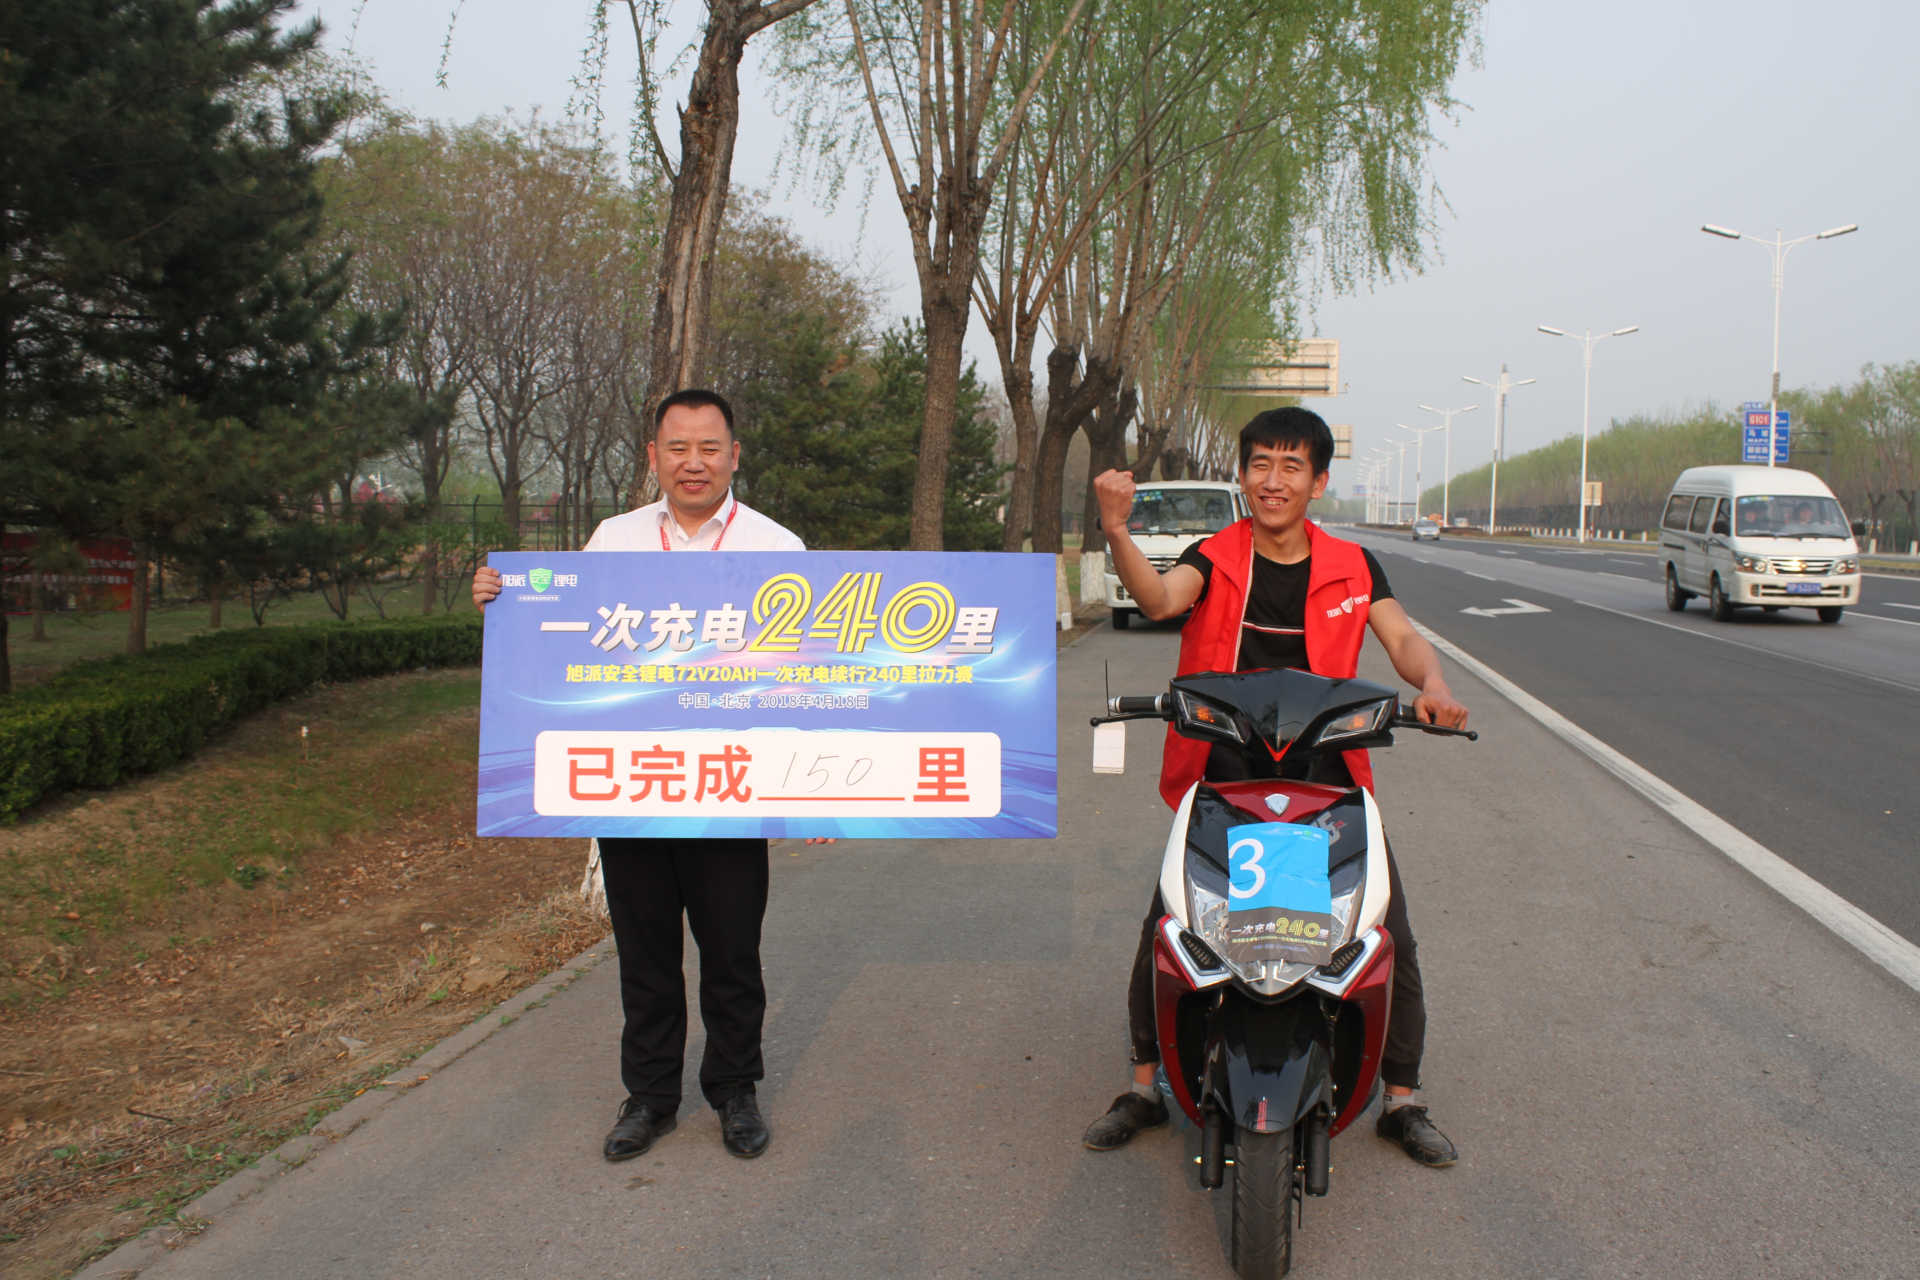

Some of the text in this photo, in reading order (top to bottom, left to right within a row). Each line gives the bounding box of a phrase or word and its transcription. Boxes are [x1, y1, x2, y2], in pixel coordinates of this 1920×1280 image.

[540, 572, 998, 654] 一次充电240里
[567, 744, 970, 803] 已完成 150 里
[1229, 838, 1265, 898] 3
